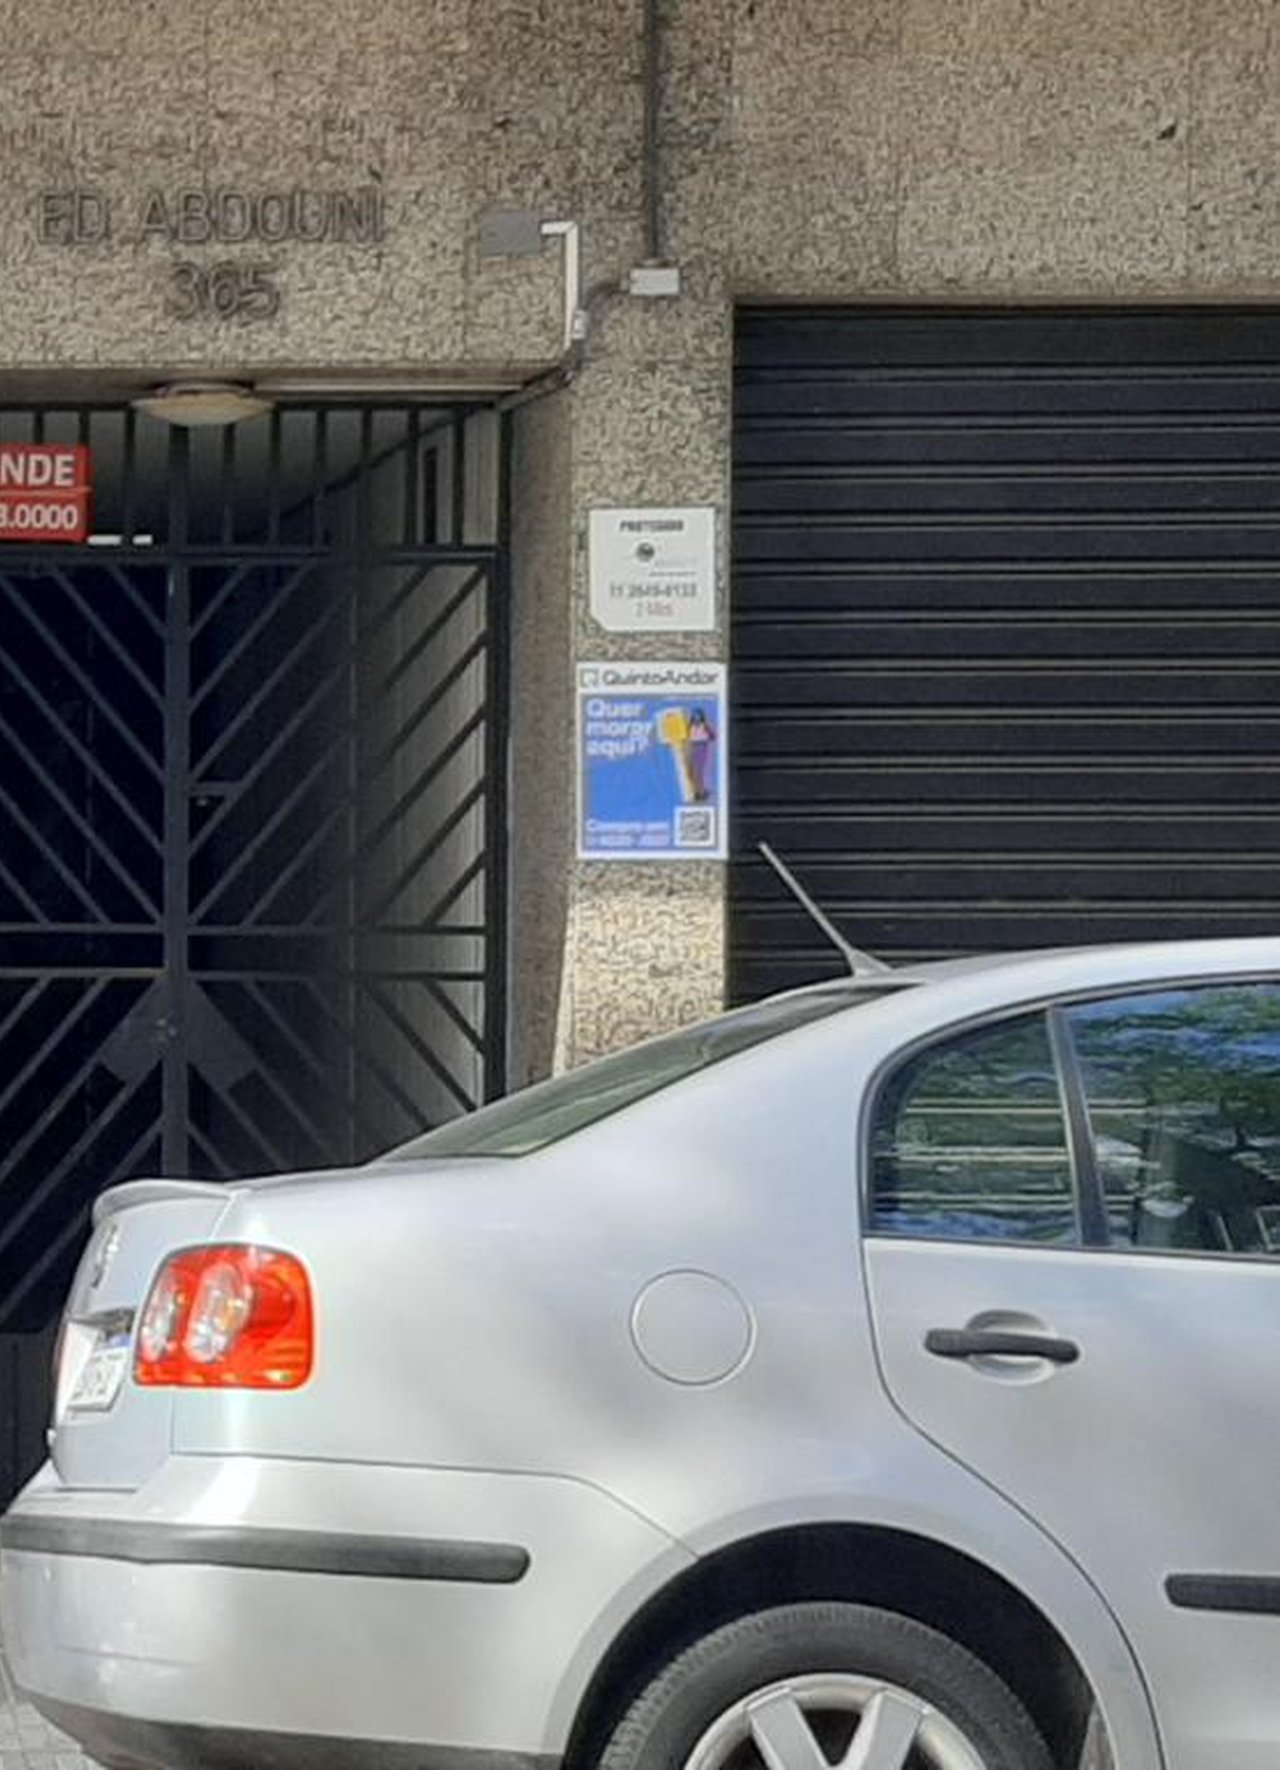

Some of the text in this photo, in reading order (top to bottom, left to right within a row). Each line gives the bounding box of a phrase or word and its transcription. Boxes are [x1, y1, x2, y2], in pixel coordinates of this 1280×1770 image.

[166, 260, 281, 322] 365
[602, 669, 719, 686] QuintoAndar
[587, 699, 646, 717] Quer
[587, 722, 653, 736] morar
[587, 737, 648, 759] aqui?
